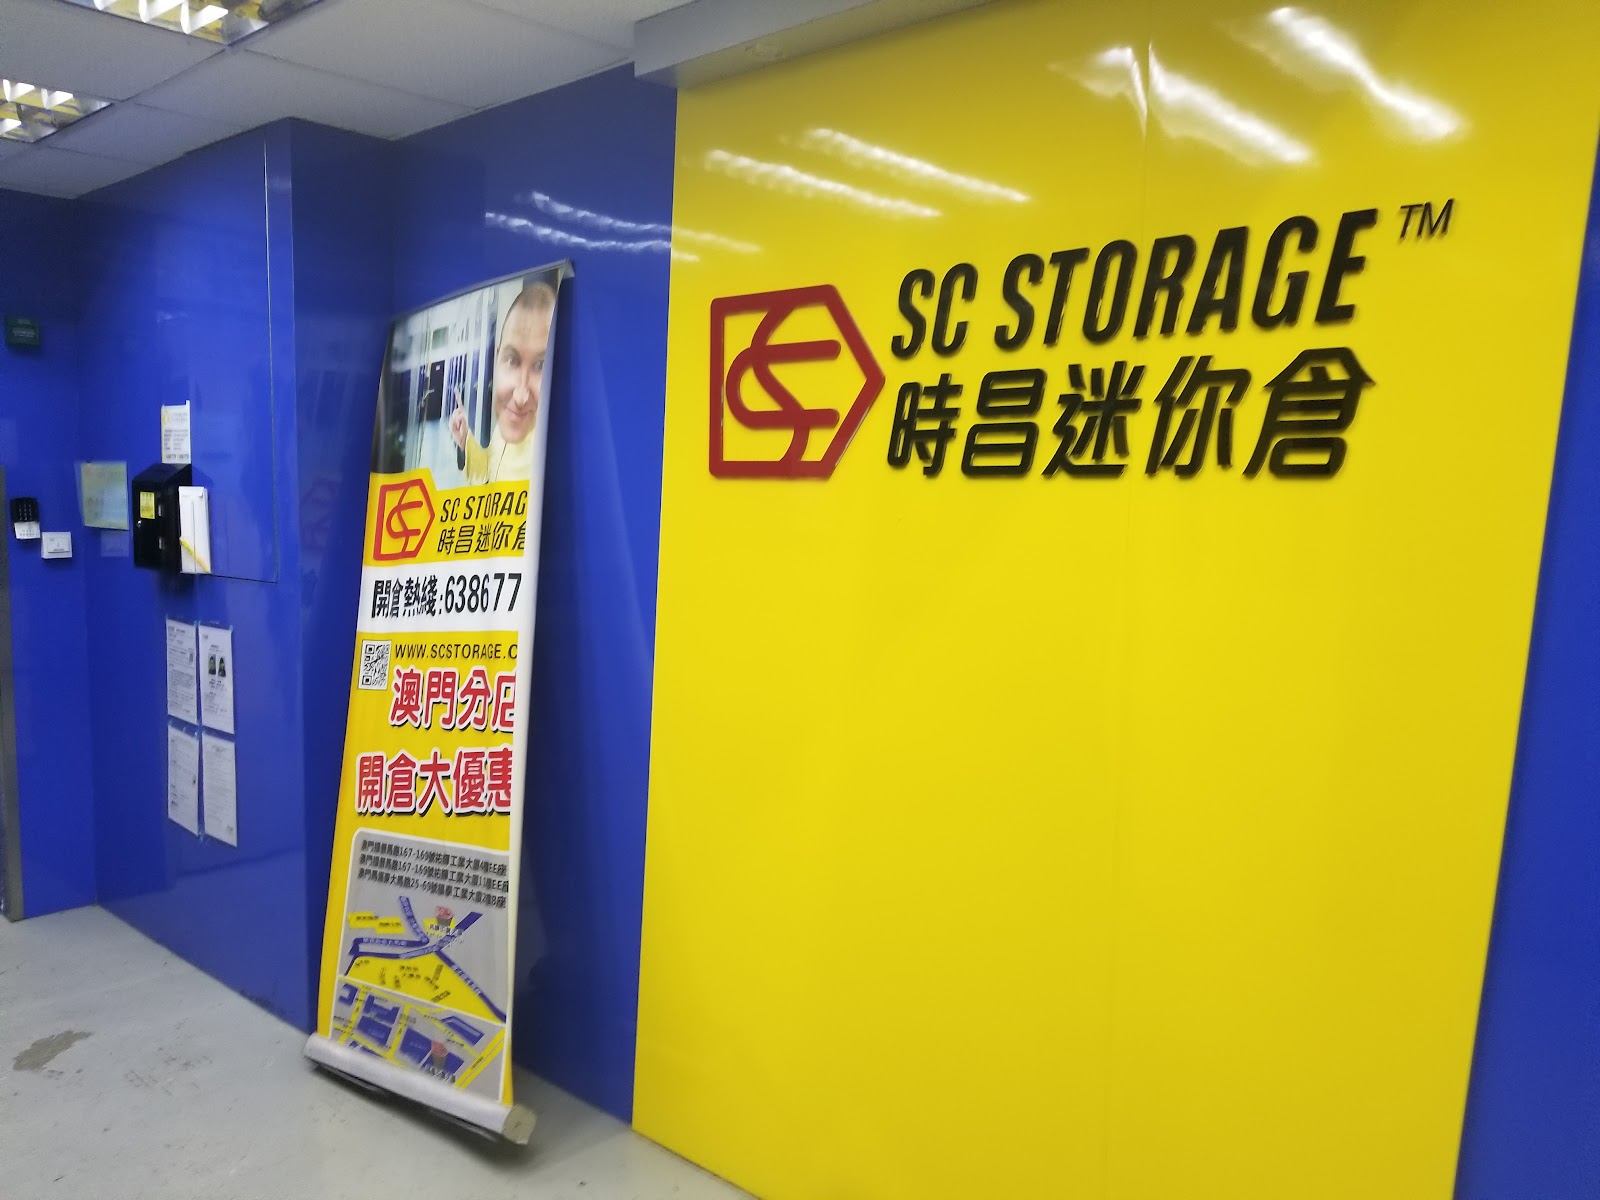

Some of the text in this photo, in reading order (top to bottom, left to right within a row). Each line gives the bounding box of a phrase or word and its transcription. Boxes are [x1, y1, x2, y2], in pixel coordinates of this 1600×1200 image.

[891, 263, 978, 360] SC
[994, 209, 1378, 351] STORAGE
[887, 346, 1375, 479] 時昌迷你倉
[440, 497, 461, 523] SC
[390, 668, 516, 728] 澳門分店
[357, 747, 513, 810] 開倉大優惠
